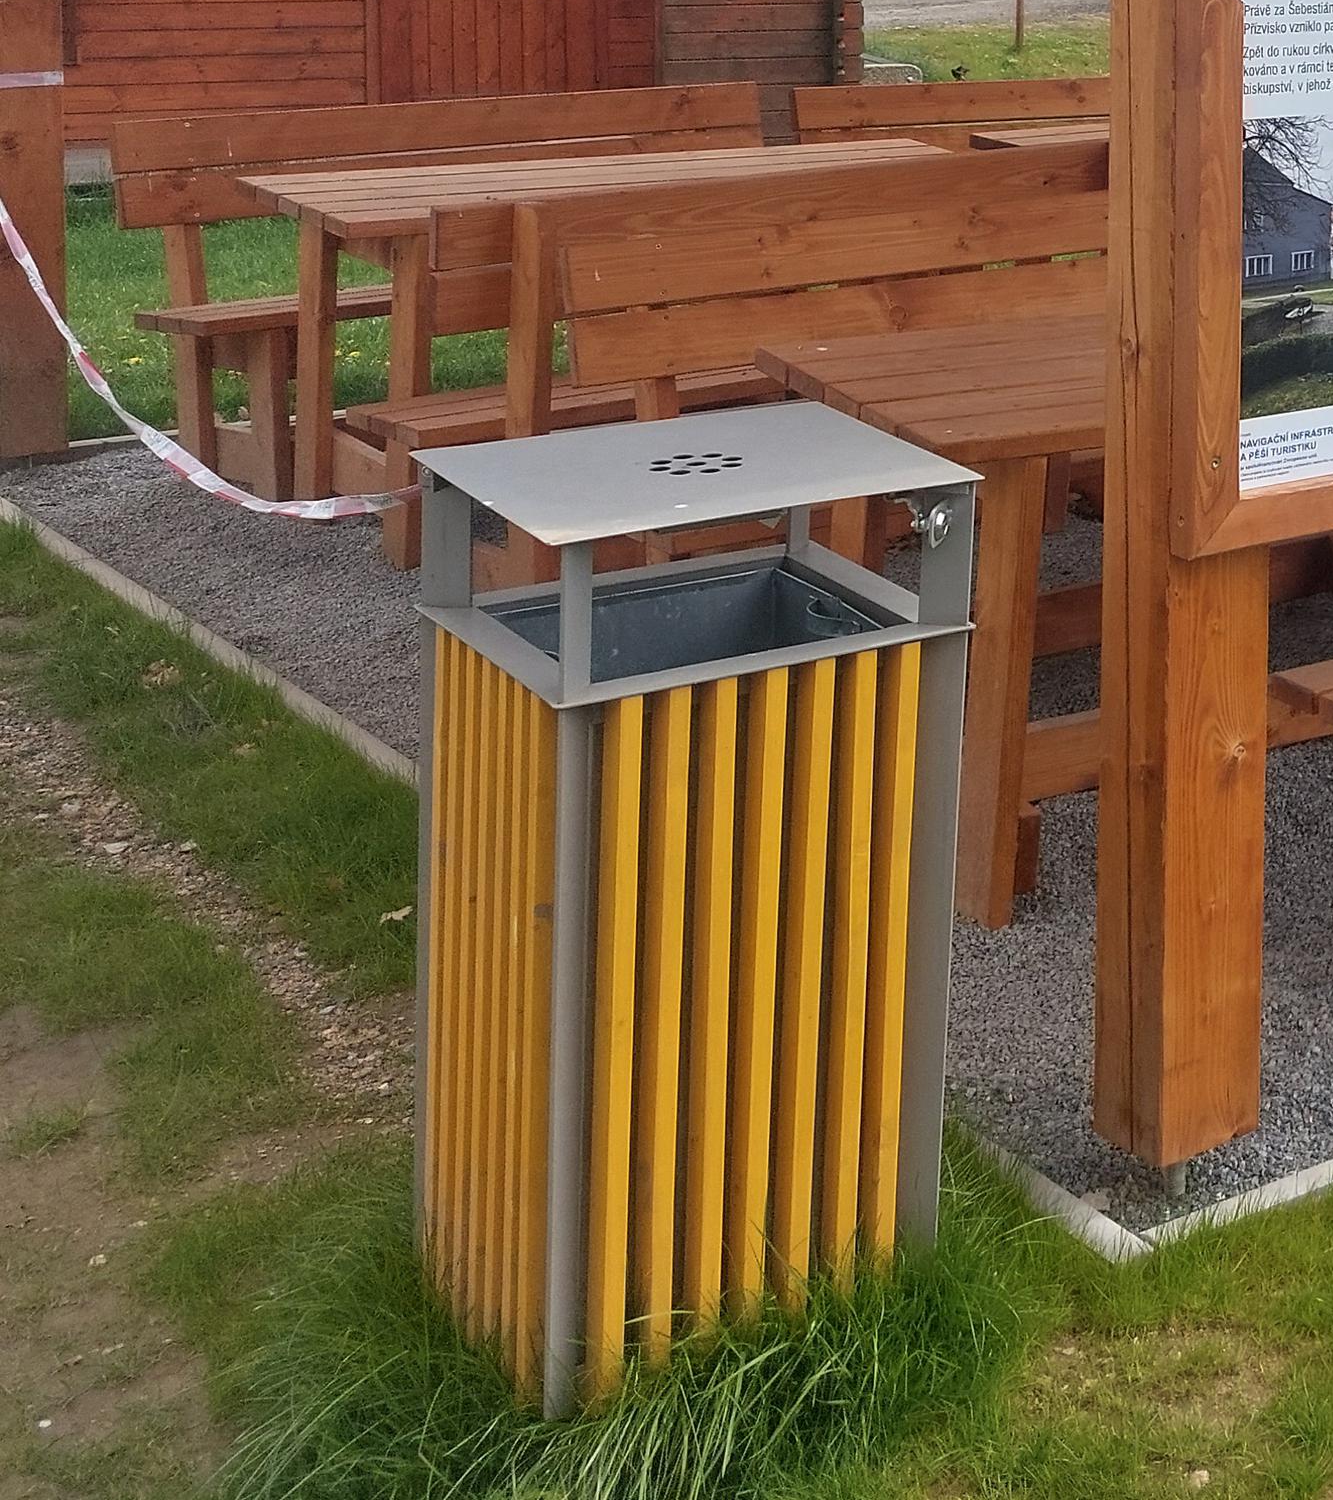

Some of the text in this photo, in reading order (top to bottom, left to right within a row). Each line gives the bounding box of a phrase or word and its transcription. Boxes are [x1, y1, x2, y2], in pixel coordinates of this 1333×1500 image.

[1244, 3, 1271, 16] Právě
[1244, 21, 1286, 34] Přízvisko
[1289, 20, 1321, 32] vzniklo
[1243, 46, 1264, 60] Zpět
[1282, 44, 1309, 56] rukou
[1297, 61, 1324, 73] rámci
[1306, 78, 1330, 93] jehož
[1240, 431, 1288, 449] NAVIGAČNÍ
[1240, 453, 1246, 461] A
[1249, 446, 1268, 460] PĚŠÍ
[1271, 441, 1317, 456] TURISTIKU
